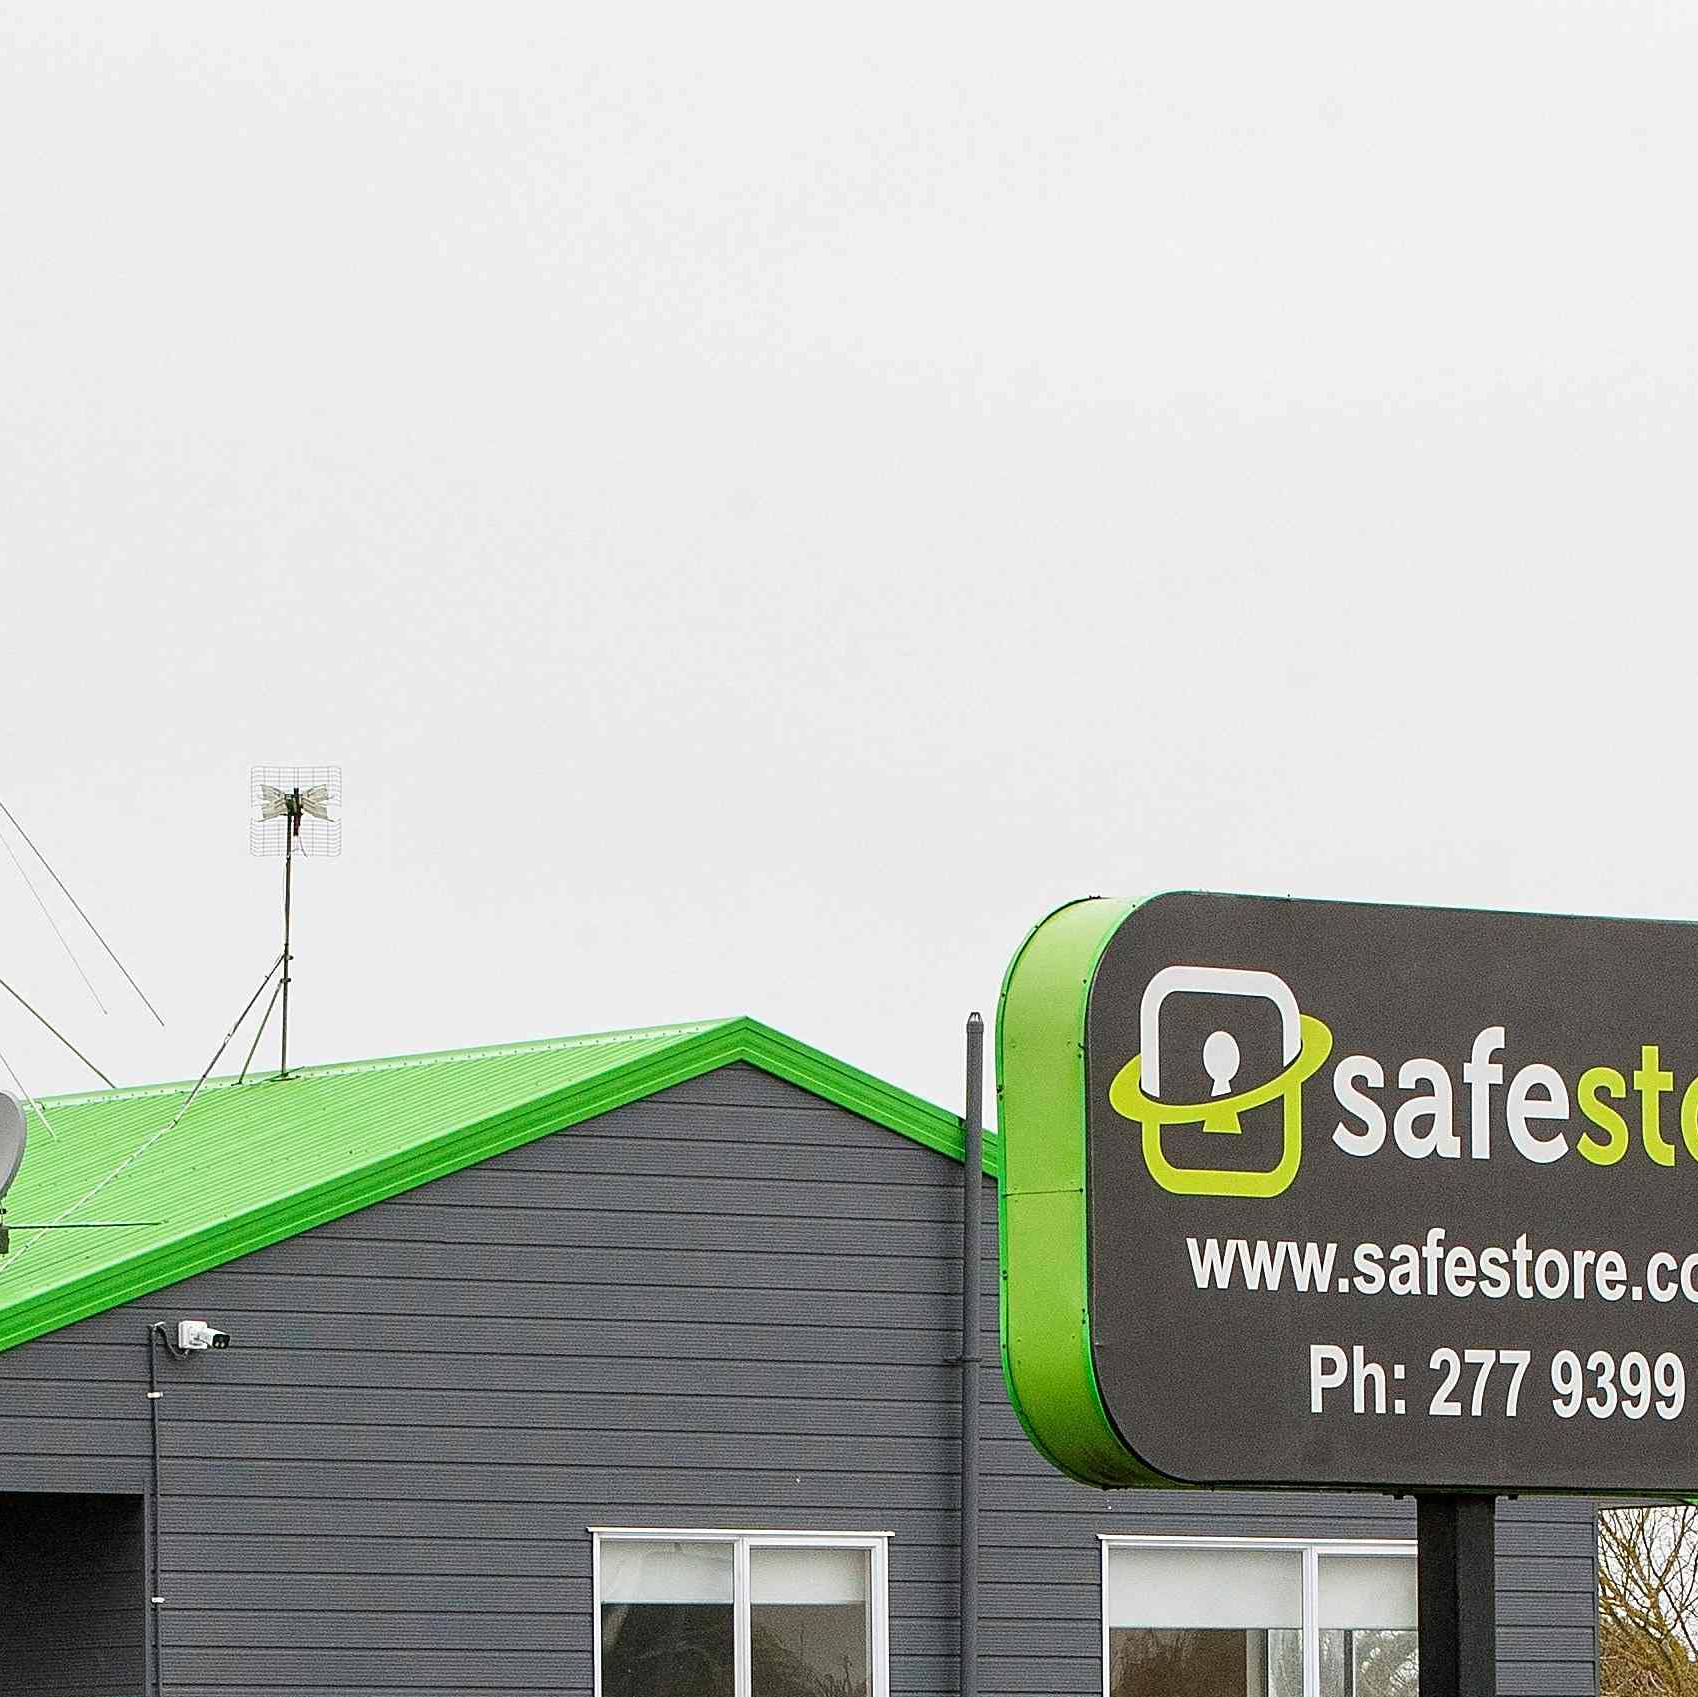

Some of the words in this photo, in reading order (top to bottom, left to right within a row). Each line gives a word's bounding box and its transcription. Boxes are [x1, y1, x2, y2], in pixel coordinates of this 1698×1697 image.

[1310, 1345, 1406, 1415] Ph:
[1428, 1348, 1531, 1417] 277
[1550, 1350, 1686, 1420] 9399
